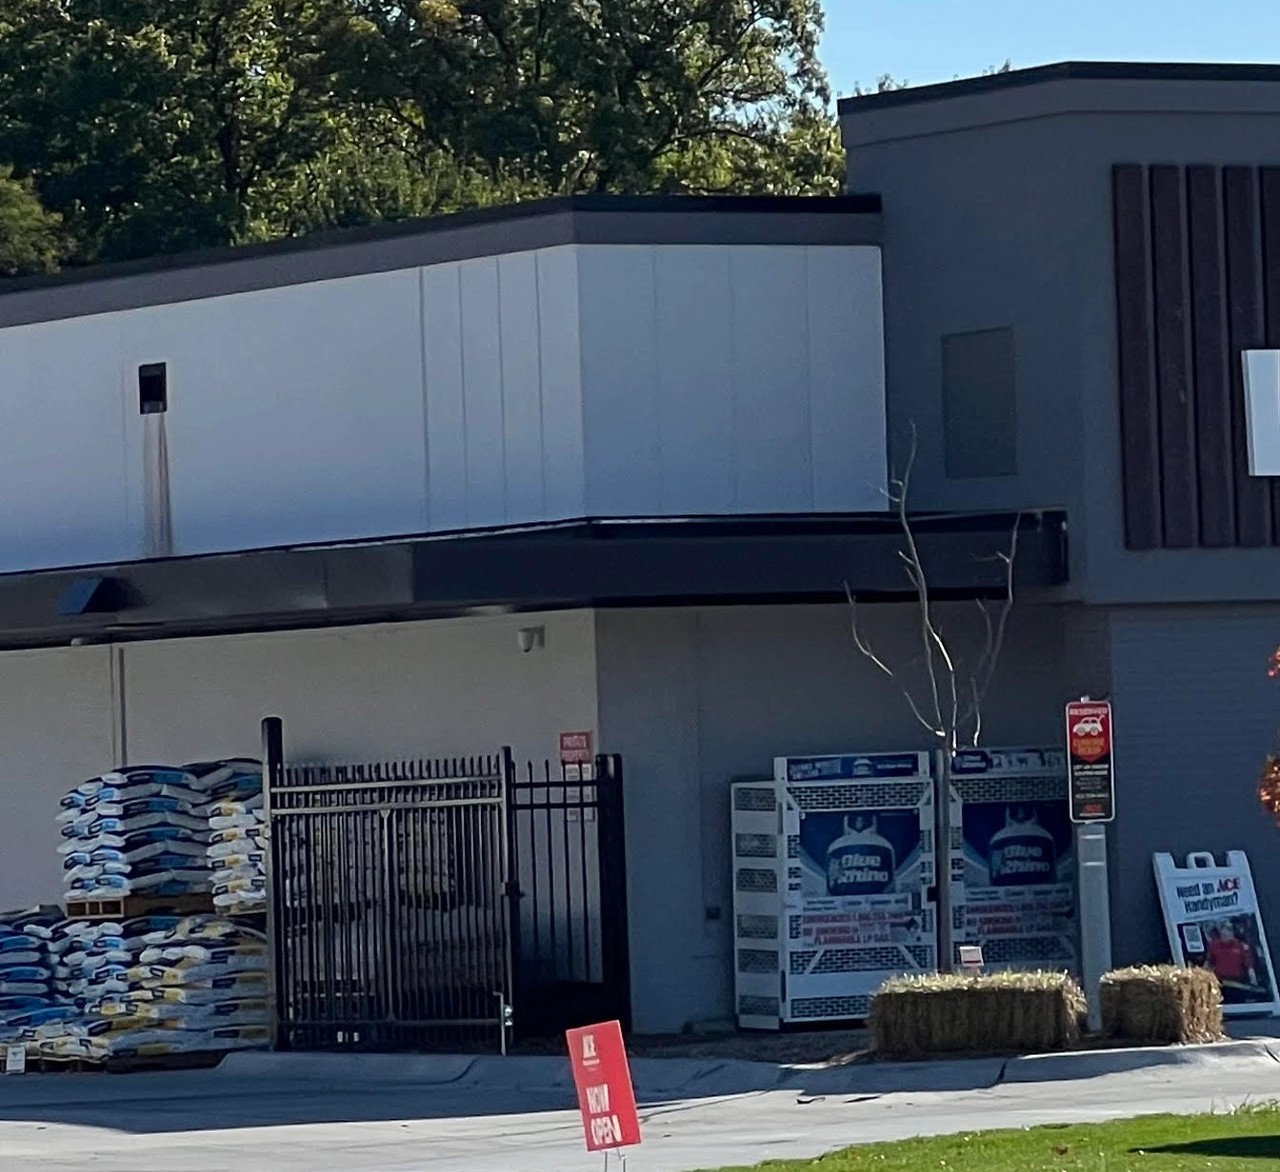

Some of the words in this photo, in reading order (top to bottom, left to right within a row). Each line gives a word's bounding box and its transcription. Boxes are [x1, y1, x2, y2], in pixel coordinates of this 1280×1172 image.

[1176, 881, 1200, 898] Need
[1203, 882, 1214, 894] an
[1217, 877, 1241, 893] ACE
[586, 1083, 610, 1114] NOW
[591, 1114, 622, 1146] OPEN
